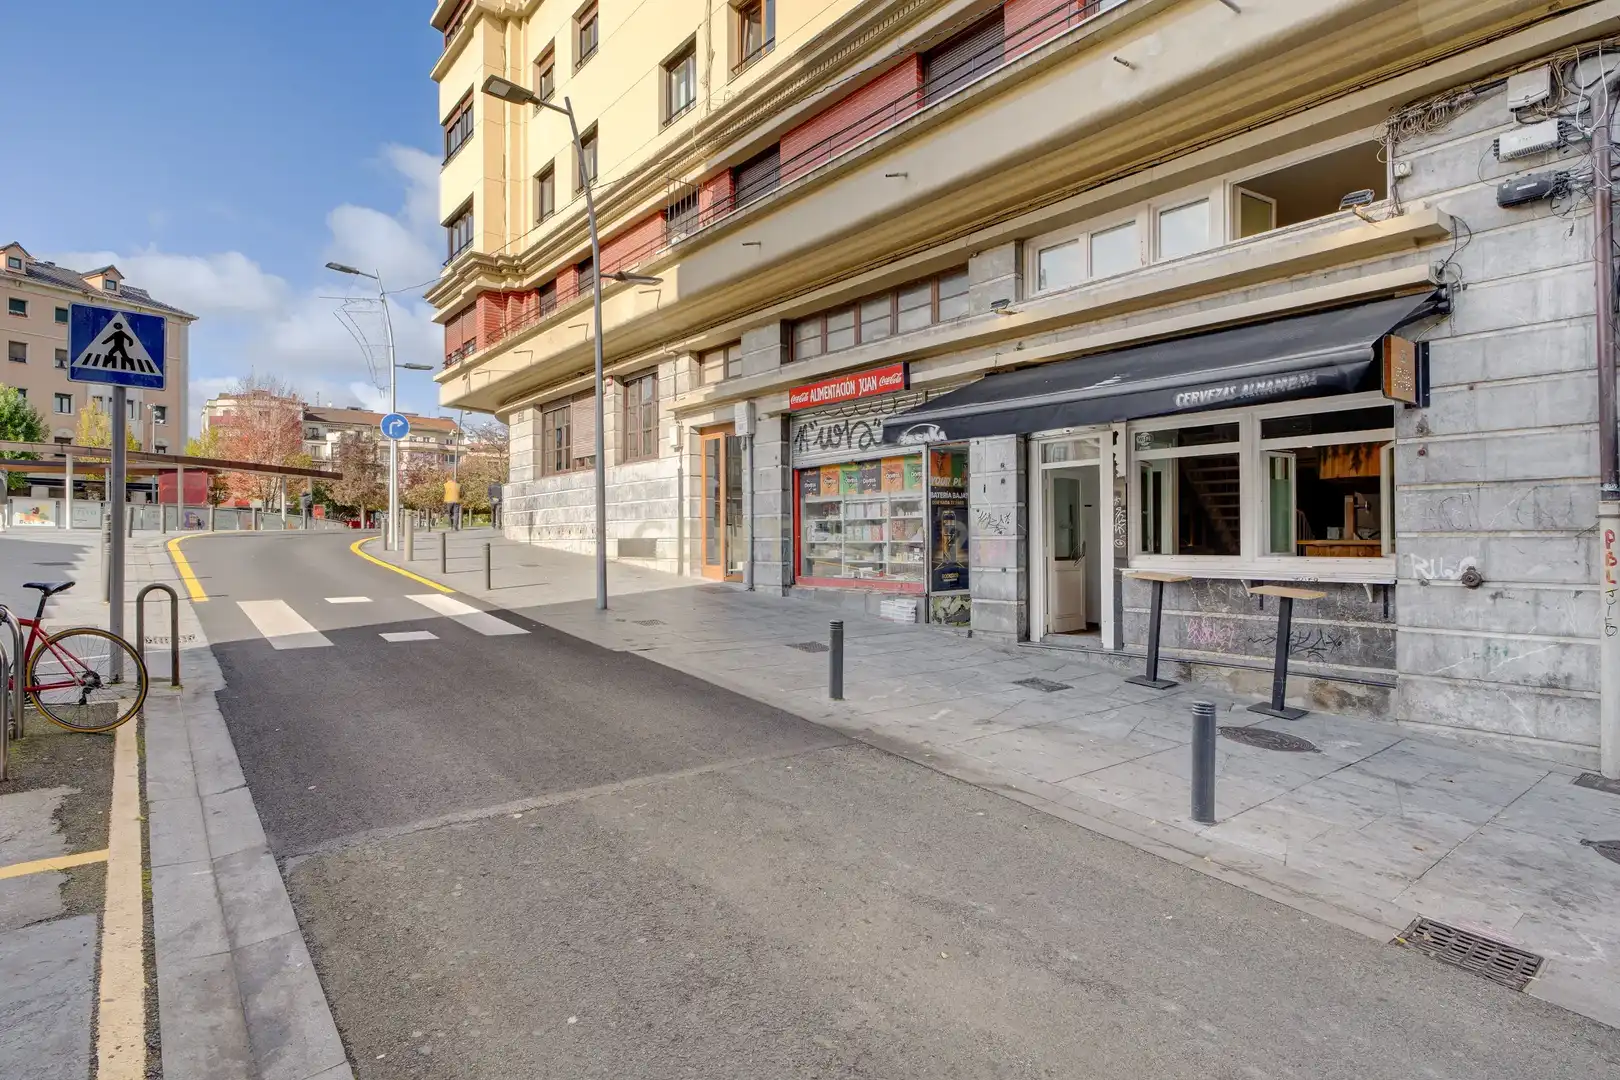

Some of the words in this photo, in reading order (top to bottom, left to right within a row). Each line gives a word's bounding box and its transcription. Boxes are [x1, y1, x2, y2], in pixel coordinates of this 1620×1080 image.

[810, 377, 856, 402] ALIMENTACIÓN
[858, 376, 877, 396] JUAN
[1175, 385, 1237, 408] CERVEZAS
